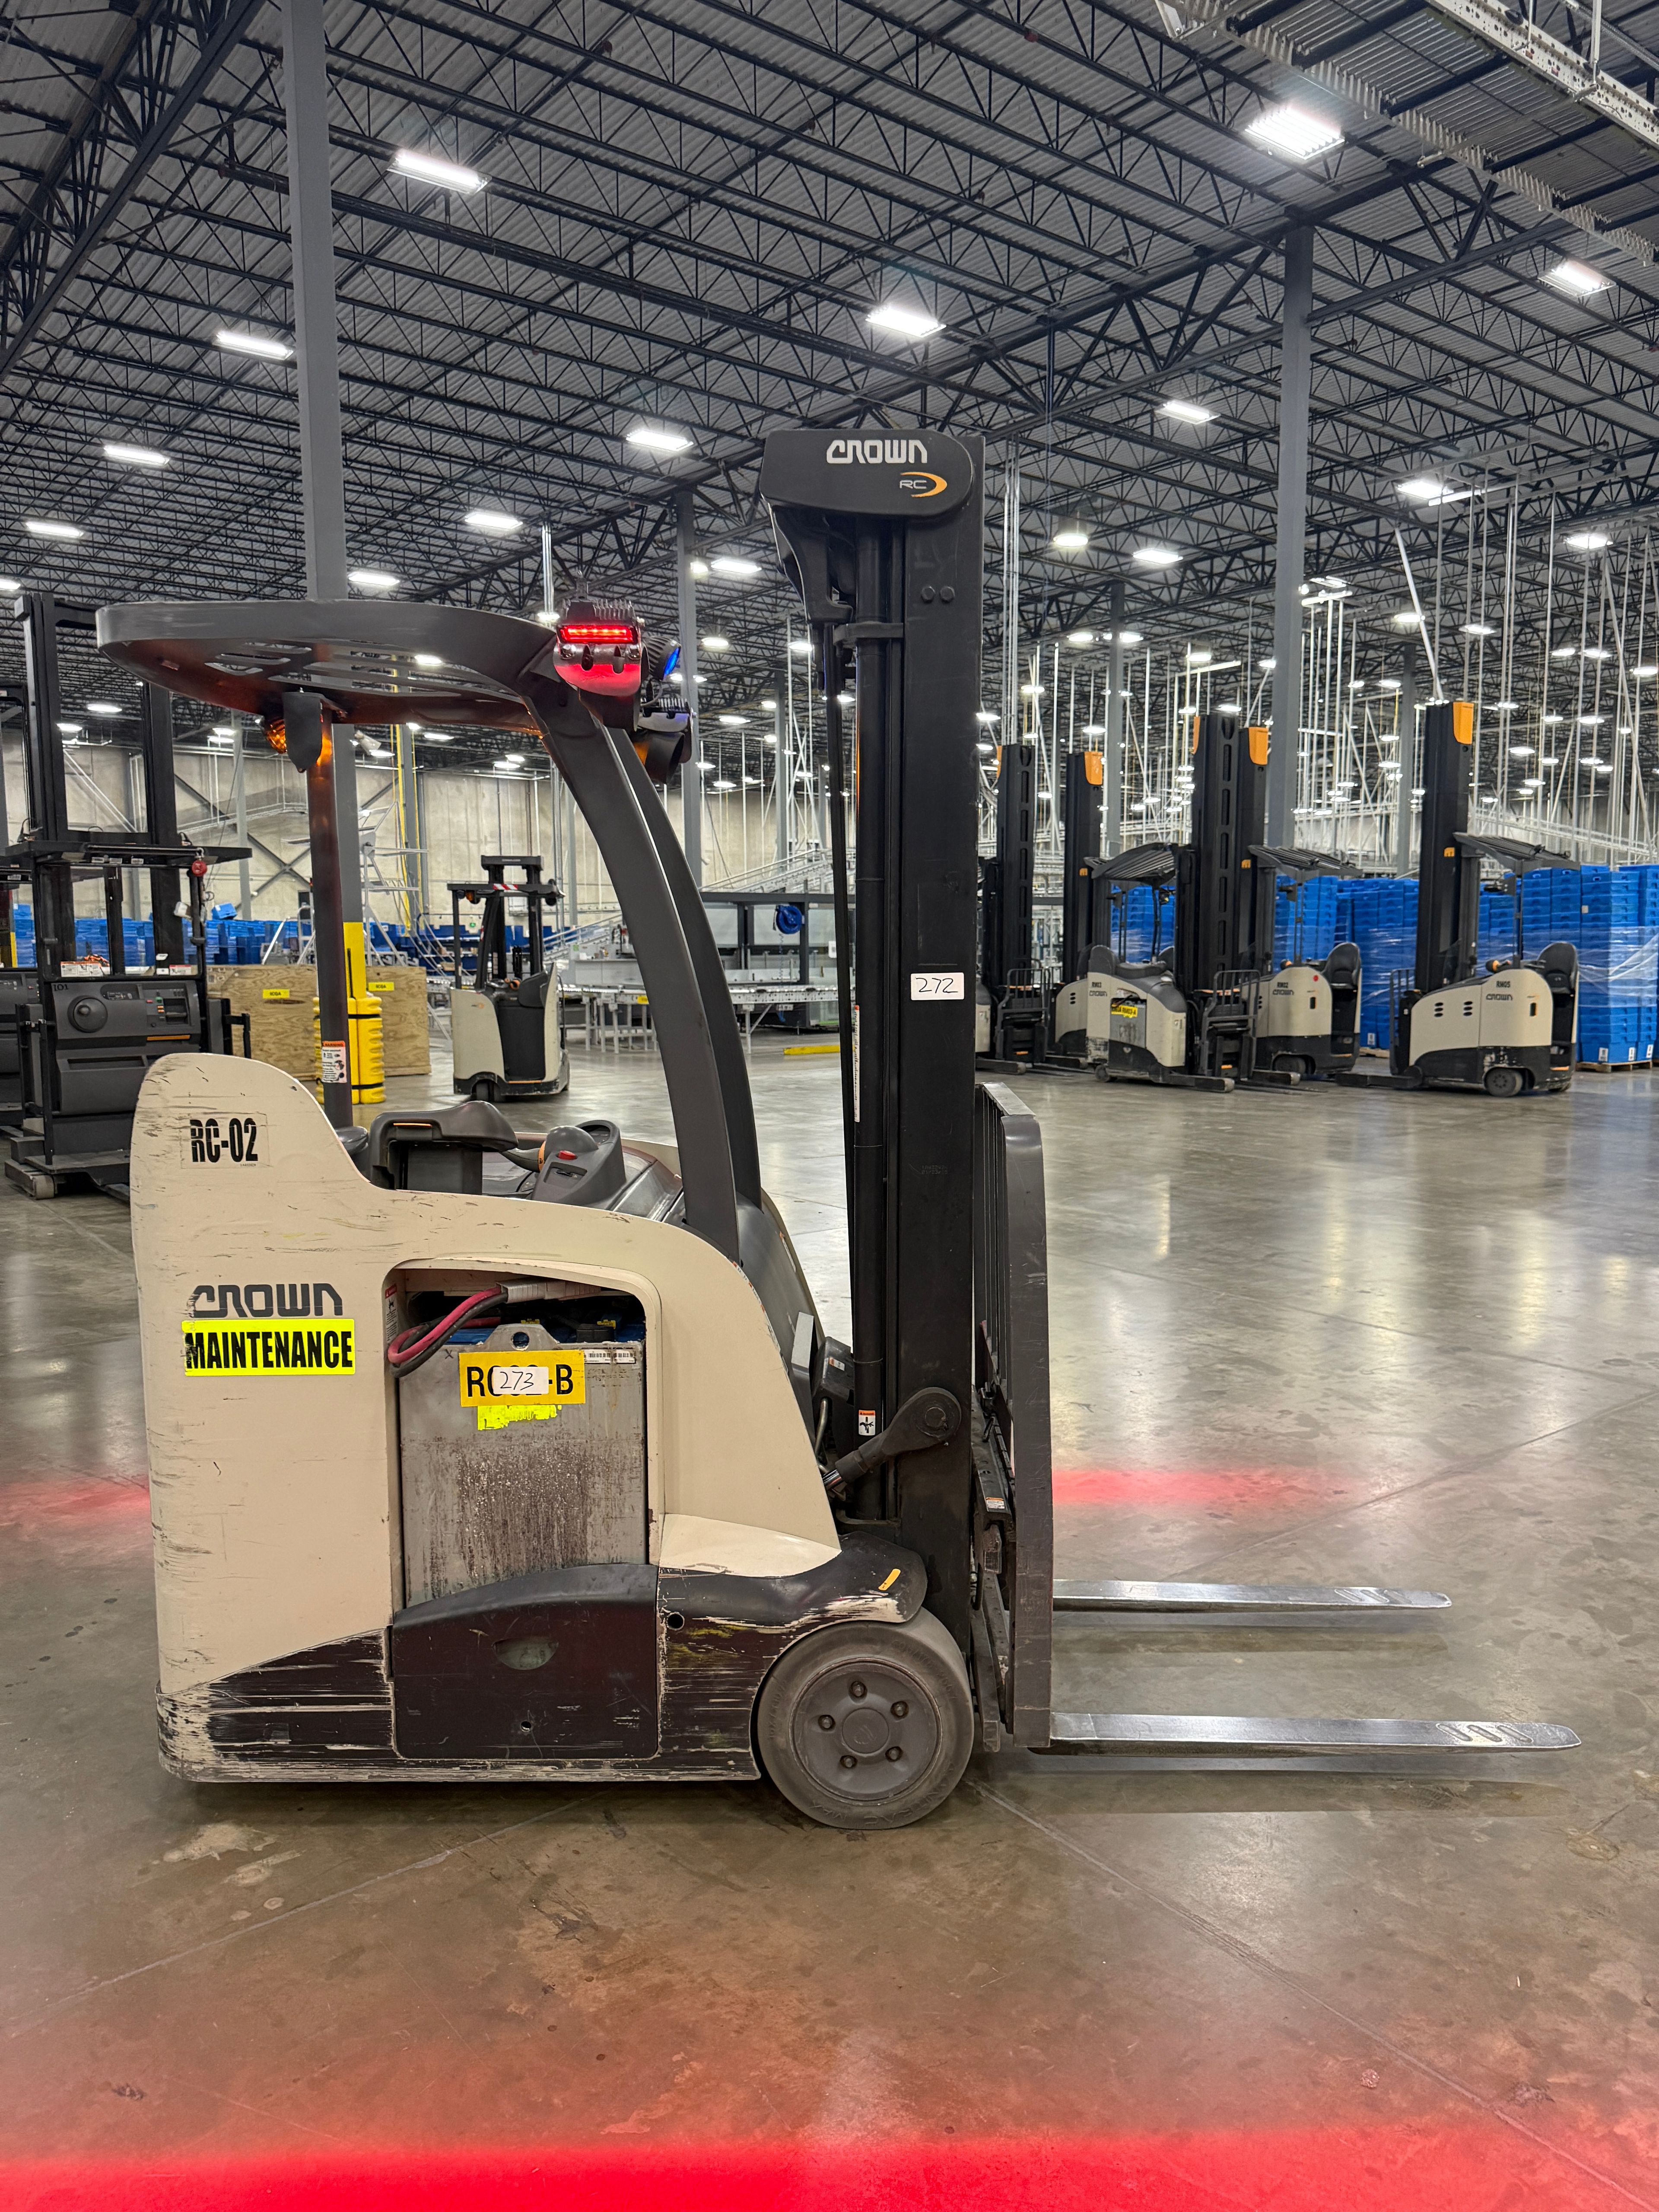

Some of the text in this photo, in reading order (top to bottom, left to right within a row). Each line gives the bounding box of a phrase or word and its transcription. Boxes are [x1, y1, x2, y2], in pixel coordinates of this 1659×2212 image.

[826, 440, 927, 464] CROWN
[899, 480, 927, 489] RC
[916, 978, 958, 993] 272
[190, 1118, 258, 1163] RC-02
[187, 1283, 343, 1318] CROWN
[186, 1331, 353, 1369] MAINTENANCE
[500, 1371, 534, 1390] 273
